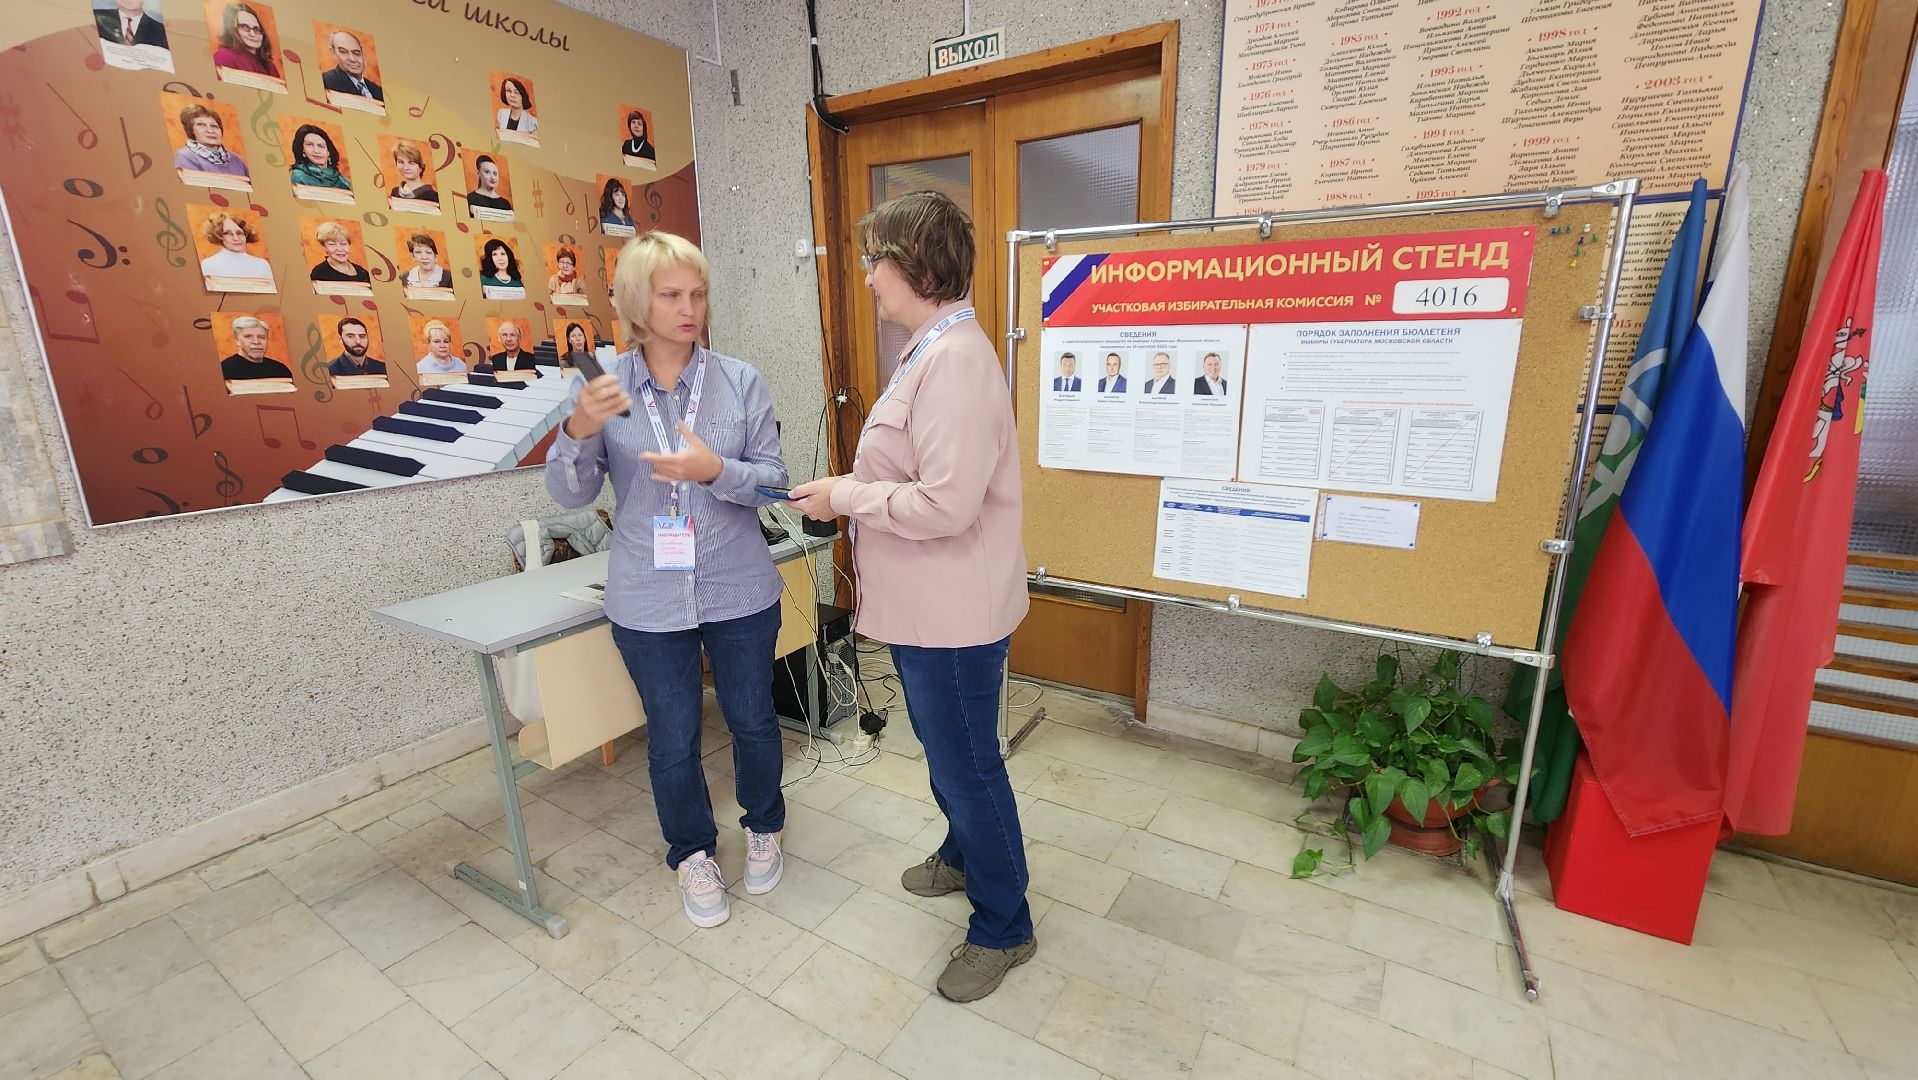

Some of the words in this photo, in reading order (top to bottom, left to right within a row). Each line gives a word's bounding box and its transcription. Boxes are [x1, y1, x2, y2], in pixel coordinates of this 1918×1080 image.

[1362, 3, 1400, 15] Светлана
[1677, 1, 1734, 15] Анастасия
[1361, 11, 1394, 21] Татьяна
[1436, 7, 1462, 20] 1992
[1464, 7, 1481, 15] год
[1688, 9, 1736, 21] Наталья
[464, 2, 570, 51] школы
[1254, 22, 1276, 33] 1974
[1277, 21, 1291, 30] год
[1419, 21, 1461, 34] Воеводина
[1462, 14, 1497, 26] Валерия
[1702, 17, 1738, 27] Ксения
[1463, 26, 1510, 40] Екатерина
[1465, 24, 1487, 32] Анна
[1693, 27, 1727, 37] Дарья
[1340, 34, 1363, 46] 1985
[1363, 33, 1379, 42] год
[1538, 29, 1567, 42] 1998
[1568, 28, 1587, 37] год
[1274, 36, 1300, 46] Марина
[1453, 37, 1487, 48] Алексей
[1566, 38, 1597, 48] Мария
[1684, 37, 1711, 47] Иван
[937, 35, 999, 67] ВЫХОД
[1450, 45, 1491, 56] Светлана
[1567, 46, 1594, 56] Юлия
[1689, 40, 1737, 53] Надежда
[1358, 48, 1392, 59] Надежда
[1567, 53, 1598, 63] Мария
[1696, 52, 1722, 60] Анна
[1252, 60, 1273, 71] 1975
[1274, 59, 1288, 67] год
[1361, 63, 1391, 72] Марина
[1562, 62, 1597, 72] Кирилл
[1364, 70, 1386, 78] Елена
[1429, 65, 1455, 78] 1993
[1456, 65, 1473, 74] год
[1548, 69, 1600, 81] Екатерина
[1447, 74, 1485, 84] Наталья
[1556, 75, 1602, 87] Светлана
[1644, 76, 1681, 90] 2003
[1683, 76, 1703, 85] год
[1452, 80, 1490, 91] Надежда
[1676, 85, 1723, 96] Татьяна
[1250, 90, 1271, 101] 1976
[1272, 90, 1286, 98] год
[1457, 88, 1489, 98] Марина
[1666, 94, 1720, 106] Светлана
[1449, 102, 1486, 111] Наталья
[1661, 103, 1722, 115] Екатерина
[1444, 110, 1476, 119] Марина
[1549, 106, 1602, 118] Александра
[1664, 111, 1725, 122] Екатерина
[1332, 117, 1355, 128] 1986
[1356, 117, 1371, 126] год
[1562, 116, 1584, 125] Вера
[1681, 120, 1713, 129] Ольга
[1248, 121, 1269, 131] 1978
[1269, 121, 1284, 129] год
[1449, 128, 1465, 137] год
[1671, 129, 1706, 139] Мария
[1264, 141, 1297, 150] Владимир
[1356, 139, 1381, 147] Ирина
[1446, 136, 1486, 146] Владимир
[1523, 136, 1551, 147] 1999
[1552, 136, 1570, 145] год
[1668, 138, 1703, 147] Мария
[1453, 144, 1477, 152] Елена
[1662, 146, 1703, 156] Михаил
[1329, 157, 1350, 168] 1987
[1352, 159, 1366, 167] год
[1446, 158, 1478, 167] Марина
[1659, 153, 1711, 163] Светлана
[1246, 163, 1265, 172] 1979
[1267, 163, 1280, 171] год
[1436, 166, 1471, 174] Татьяна
[1657, 162, 1713, 173] Александр
[1437, 173, 1469, 181] Алексей
[1416, 189, 1440, 199] 1995
[1441, 190, 1457, 198] год
[1090, 243, 1383, 284] ИНФОРМАЦИОННЫЙ
[1391, 240, 1511, 274] СТЕНД
[1091, 301, 1166, 314] УЧАСТКОВАЯ
[1167, 298, 1274, 312] ИЗБИРАТЕЛЬНАЯ
[1275, 295, 1354, 309] КОМИССИЯ
[1364, 294, 1382, 306] №
[1415, 283, 1478, 308] 4016
[1402, 328, 1461, 336] БЮЛЛЕТЕНЯ
